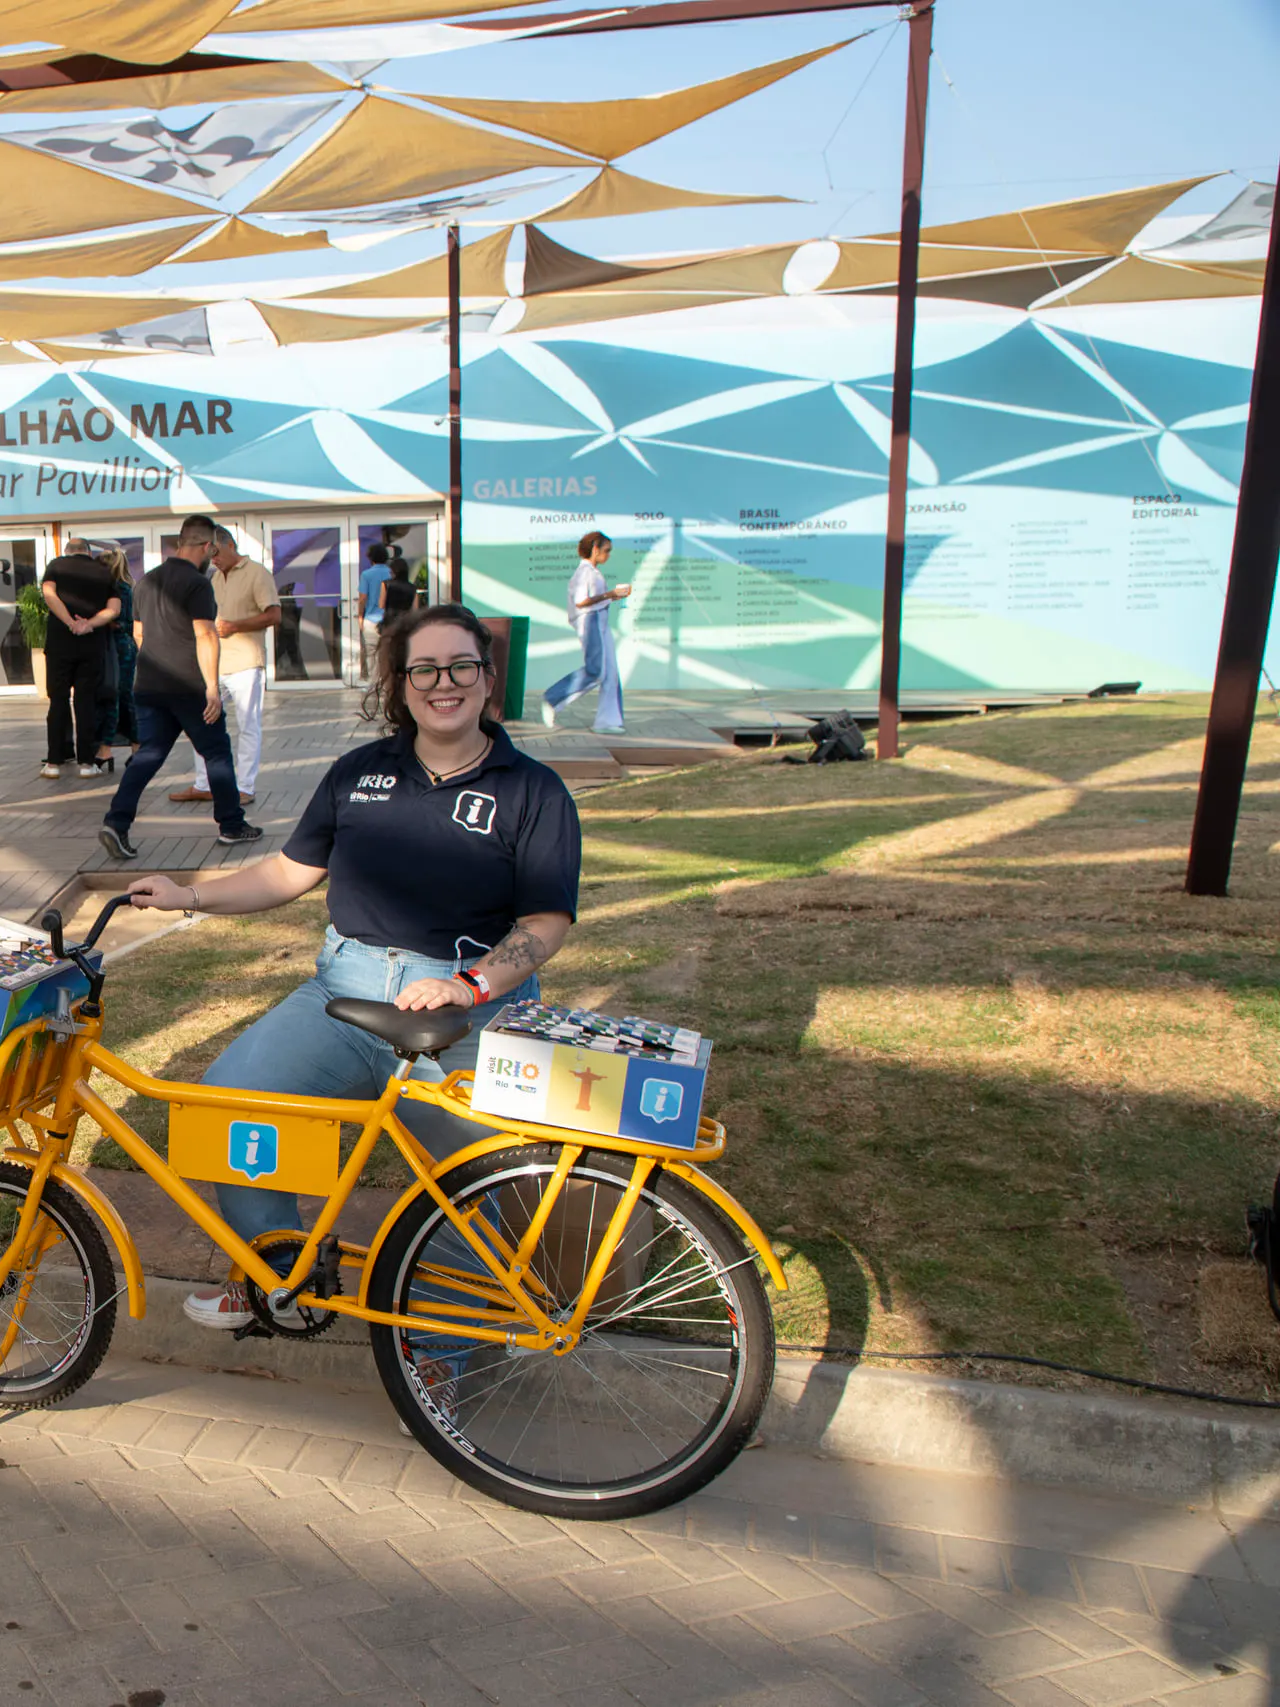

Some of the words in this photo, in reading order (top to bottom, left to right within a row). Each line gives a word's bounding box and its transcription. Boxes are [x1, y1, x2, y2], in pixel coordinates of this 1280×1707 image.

[131, 399, 234, 440] MAR
[36, 456, 185, 497] Pavillion
[472, 475, 598, 500] GALERIAS
[738, 508, 781, 520] BRASIL
[907, 500, 967, 514] XPANSÃO
[1131, 507, 1200, 520] EDITORIAL
[529, 512, 596, 524] PANORAMA
[634, 511, 665, 521] SOLO
[739, 518, 849, 532] CONTEMPORÂNEO
[496, 1057, 540, 1081] RIO
[495, 1079, 509, 1089] Rio
